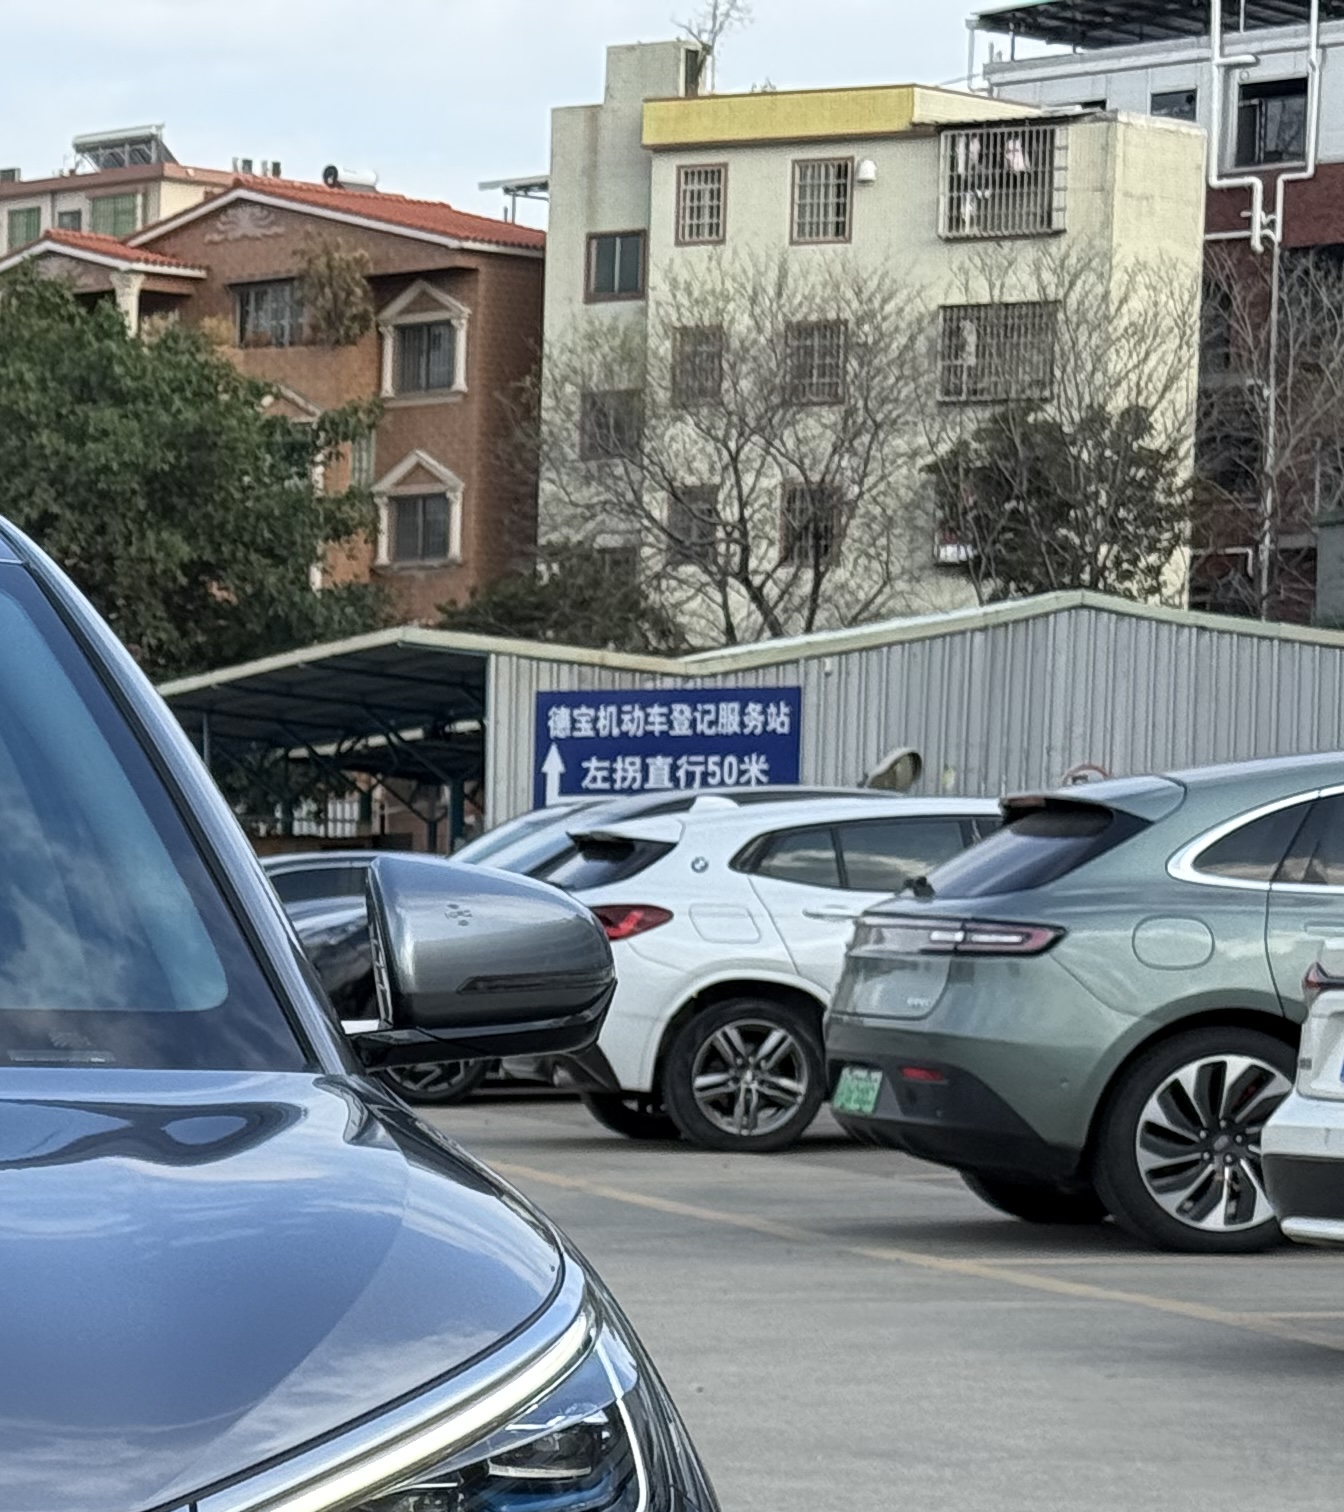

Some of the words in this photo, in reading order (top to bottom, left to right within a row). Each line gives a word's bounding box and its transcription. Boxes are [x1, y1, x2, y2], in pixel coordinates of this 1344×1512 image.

[547, 702, 790, 740] 德宝机动车登记服务站
[581, 753, 770, 789] 左拐直行50米
